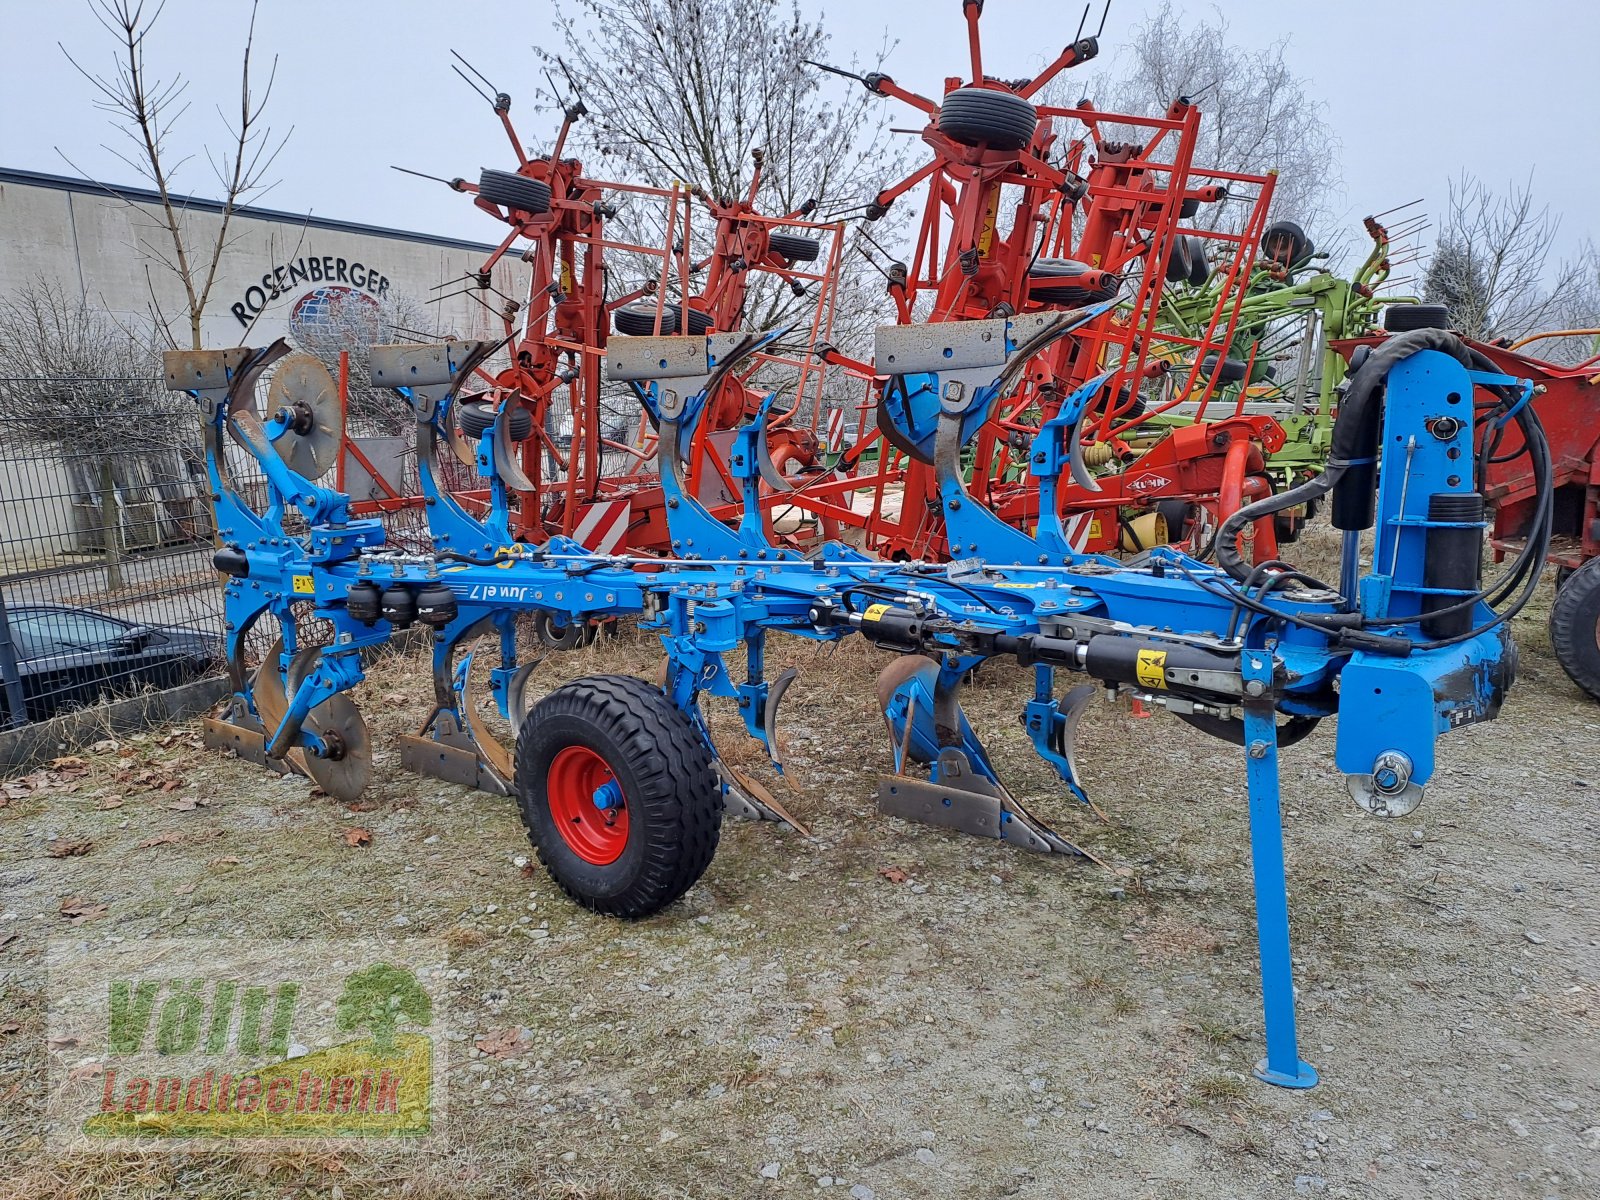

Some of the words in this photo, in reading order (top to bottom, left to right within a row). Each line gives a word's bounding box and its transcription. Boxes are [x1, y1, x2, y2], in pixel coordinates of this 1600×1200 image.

[231, 256, 390, 328] ROSENBERGER
[1131, 478, 1165, 489] KUHN
[470, 585, 480, 600] 7
